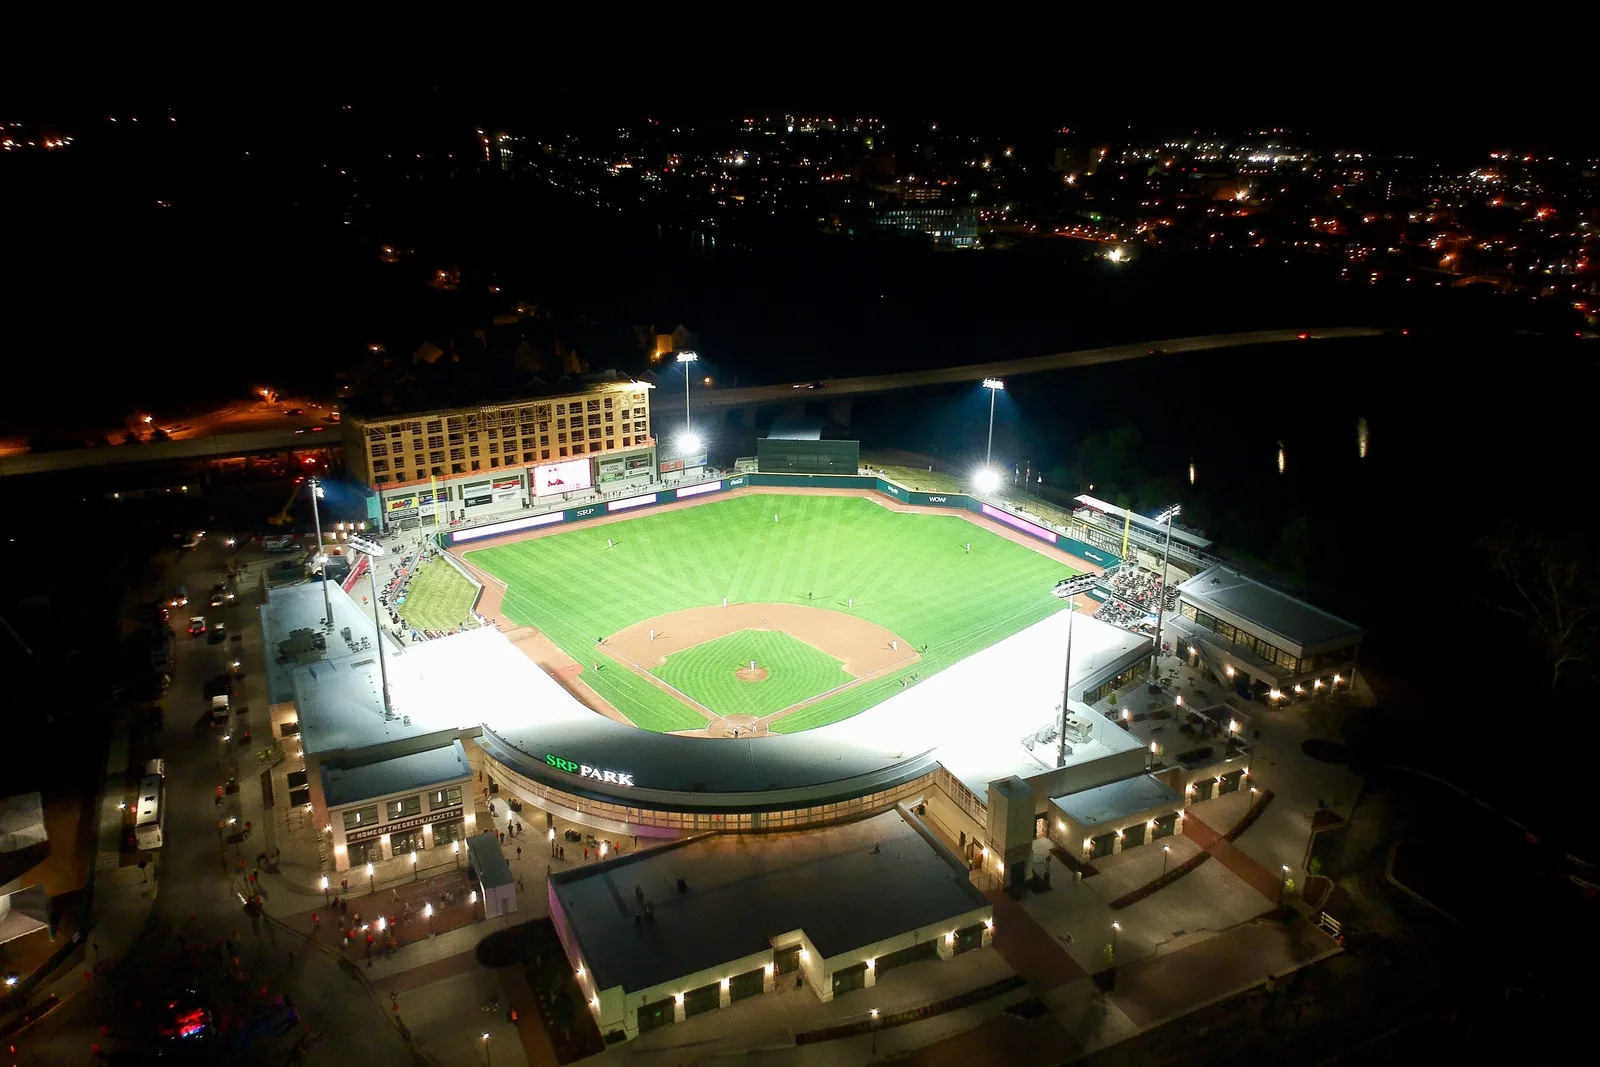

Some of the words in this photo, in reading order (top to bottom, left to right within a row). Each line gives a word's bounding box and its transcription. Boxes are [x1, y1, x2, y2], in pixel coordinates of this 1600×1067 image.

[576, 508, 595, 517] SRP
[546, 753, 578, 772] SRP
[580, 764, 635, 787] PARK
[357, 828, 378, 839] HOME
[378, 826, 387, 834] OF
[387, 822, 402, 832] THE
[402, 818, 424, 829] GREEN
[424, 811, 455, 823] JACKETS
